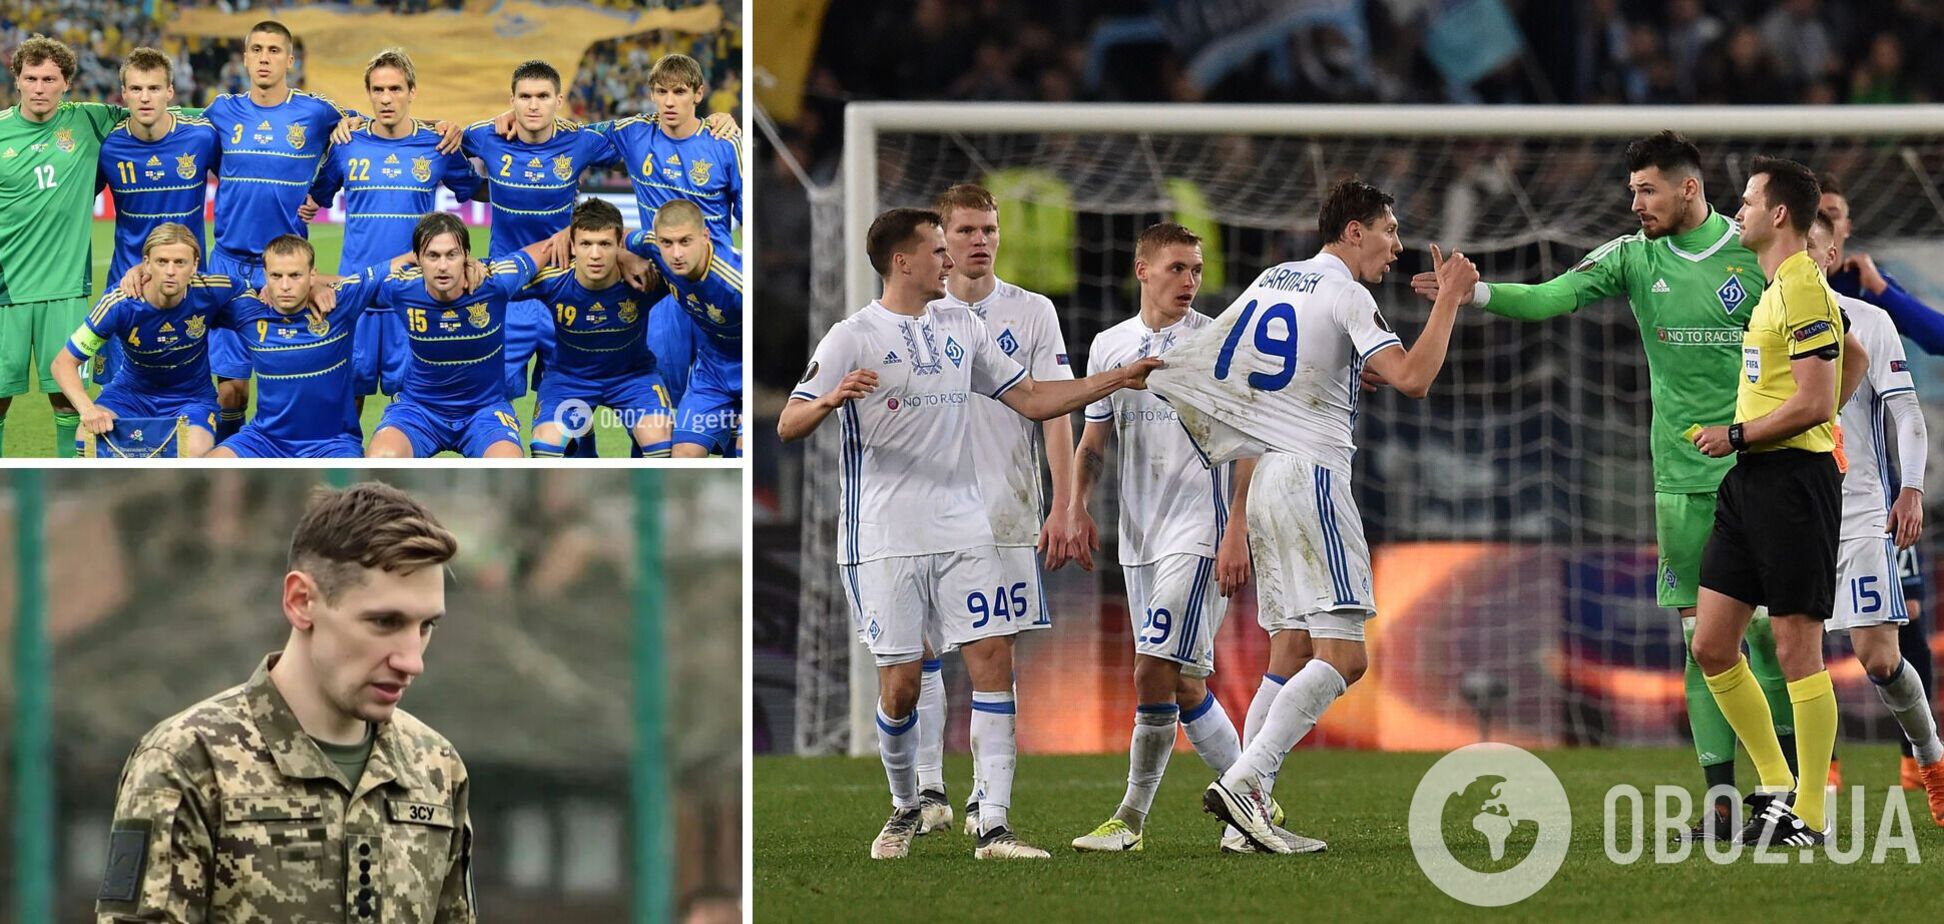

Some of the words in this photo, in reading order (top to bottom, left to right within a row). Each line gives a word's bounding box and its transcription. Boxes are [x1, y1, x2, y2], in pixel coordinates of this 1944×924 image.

[231, 123, 244, 144] 3
[117, 161, 137, 184] 11
[348, 158, 370, 181] 22
[500, 154, 512, 177] 2
[642, 153, 653, 176] 6
[34, 164, 57, 190] 12
[1258, 268, 1324, 294] GARMASH
[407, 308, 427, 333] 15
[556, 303, 577, 327] 19
[128, 327, 141, 347] 4
[256, 319, 268, 343] 9
[1667, 331, 1683, 342] NO
[1686, 331, 1702, 342] TO
[1214, 299, 1298, 391] 19
[903, 396, 921, 408] NO
[925, 394, 938, 406] TO
[1140, 410, 1154, 421] TO
[1851, 576, 1881, 613] 15
[1139, 607, 1171, 644] 29
